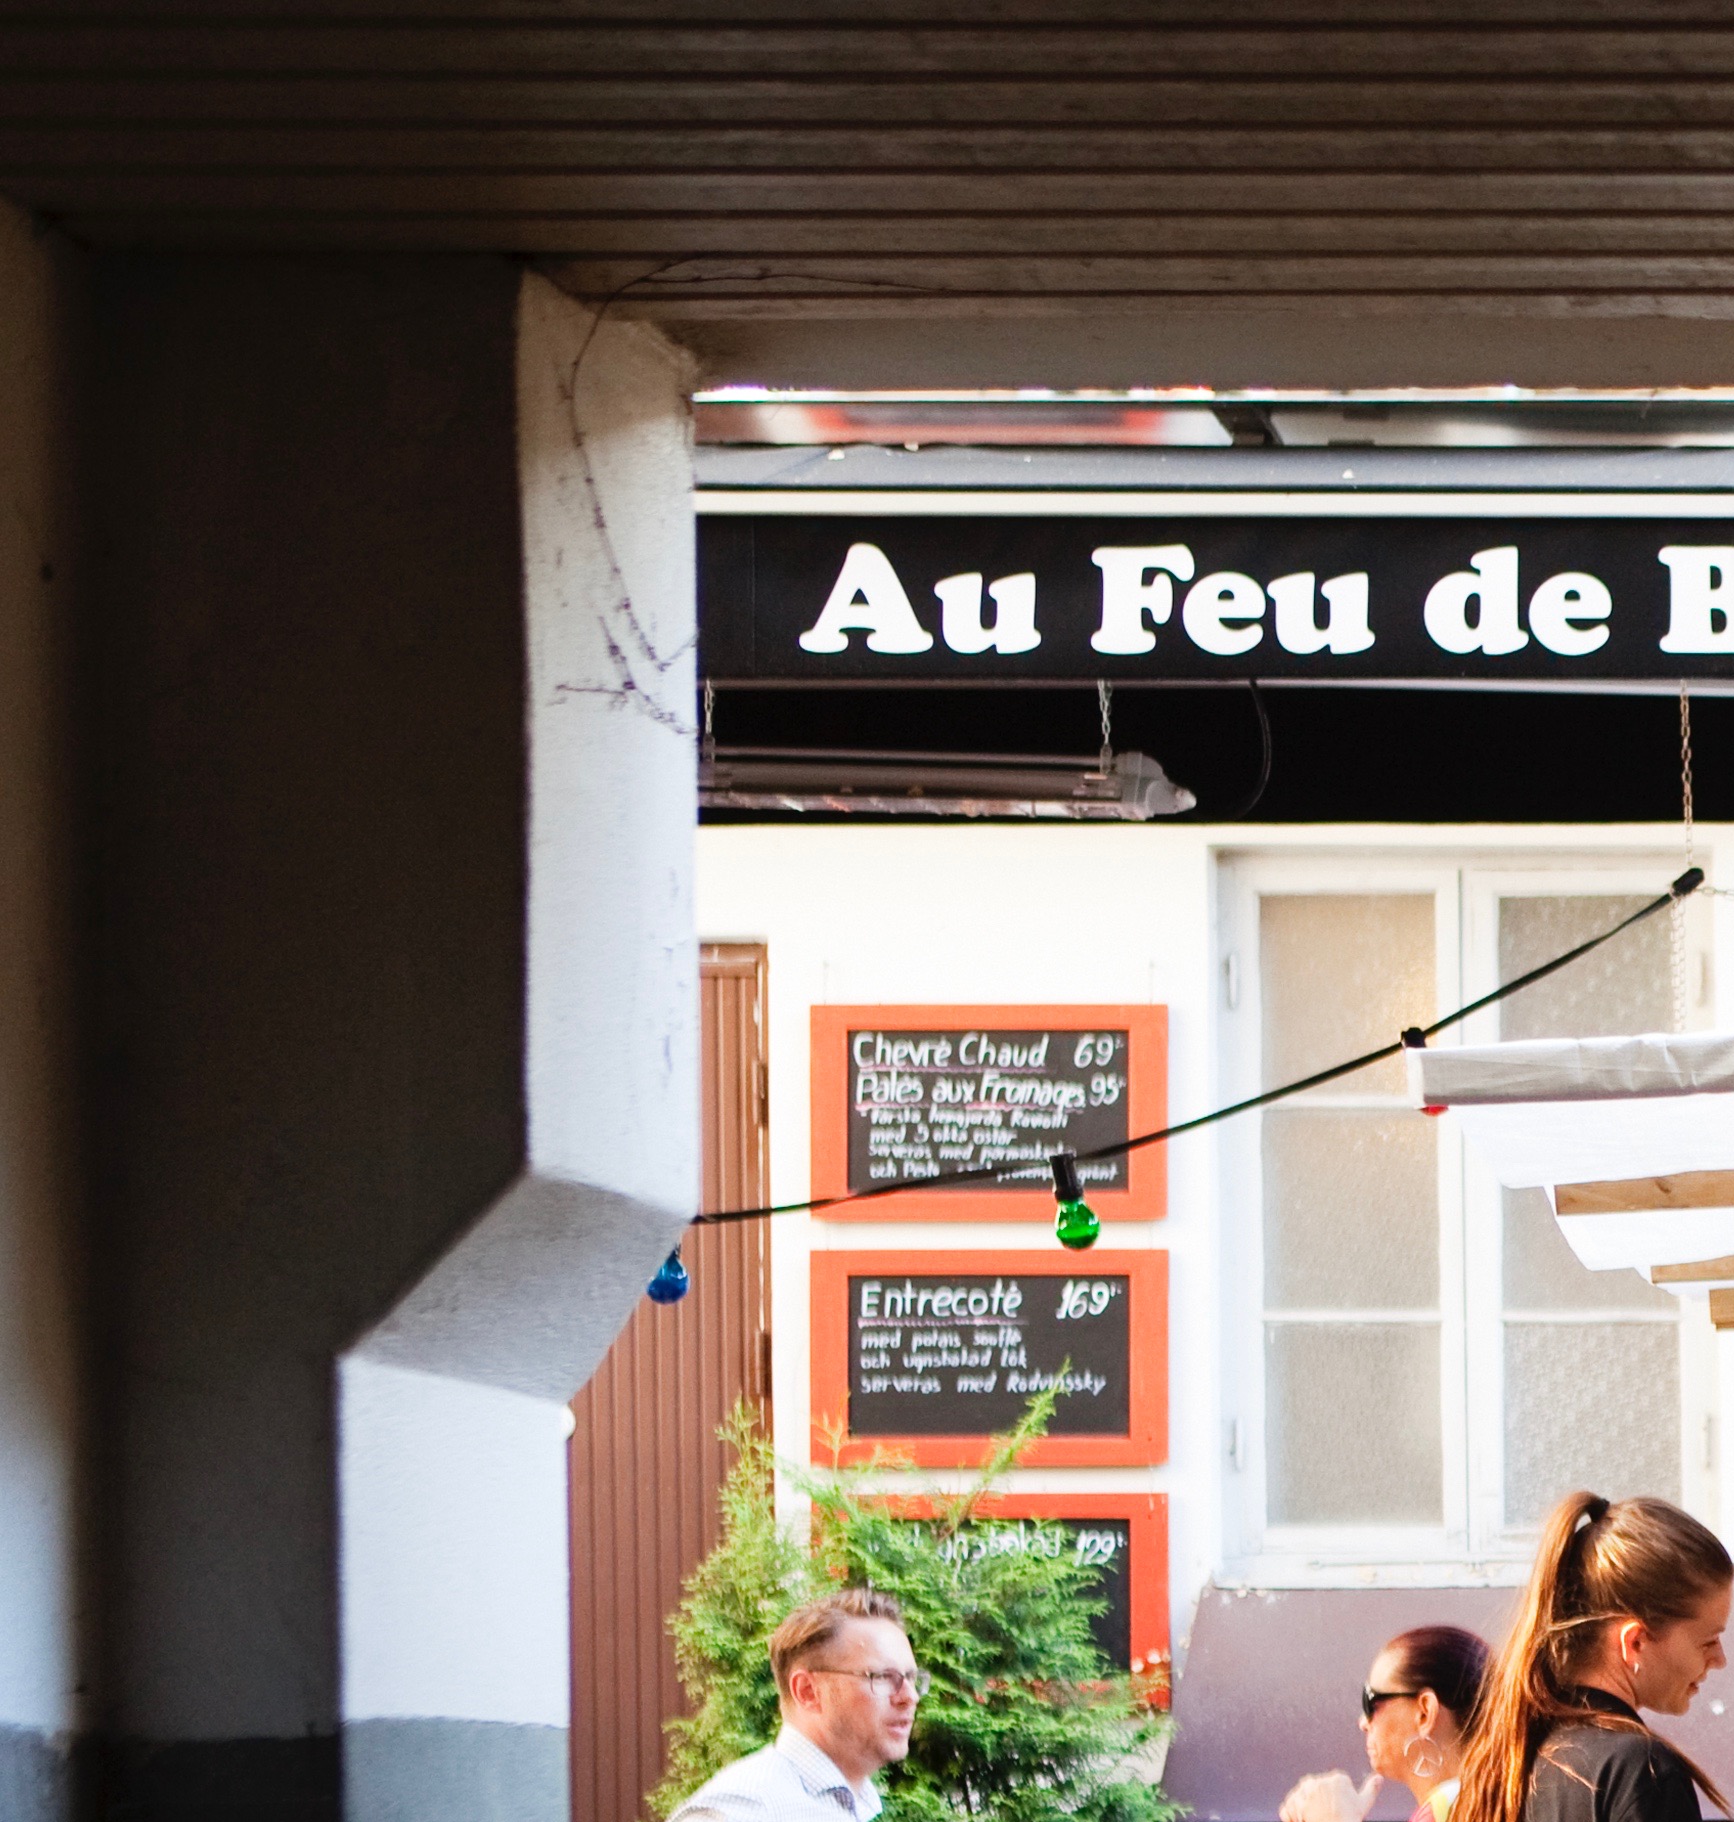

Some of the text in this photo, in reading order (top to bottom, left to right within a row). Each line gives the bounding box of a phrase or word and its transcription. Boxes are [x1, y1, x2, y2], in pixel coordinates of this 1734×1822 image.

[799, 544, 1041, 653] Au
[1091, 545, 1375, 655] Feu
[1424, 547, 1612, 655] de
[958, 1032, 1049, 1067] Chaud
[931, 1077, 976, 1103] aux
[957, 1370, 996, 1393] med
